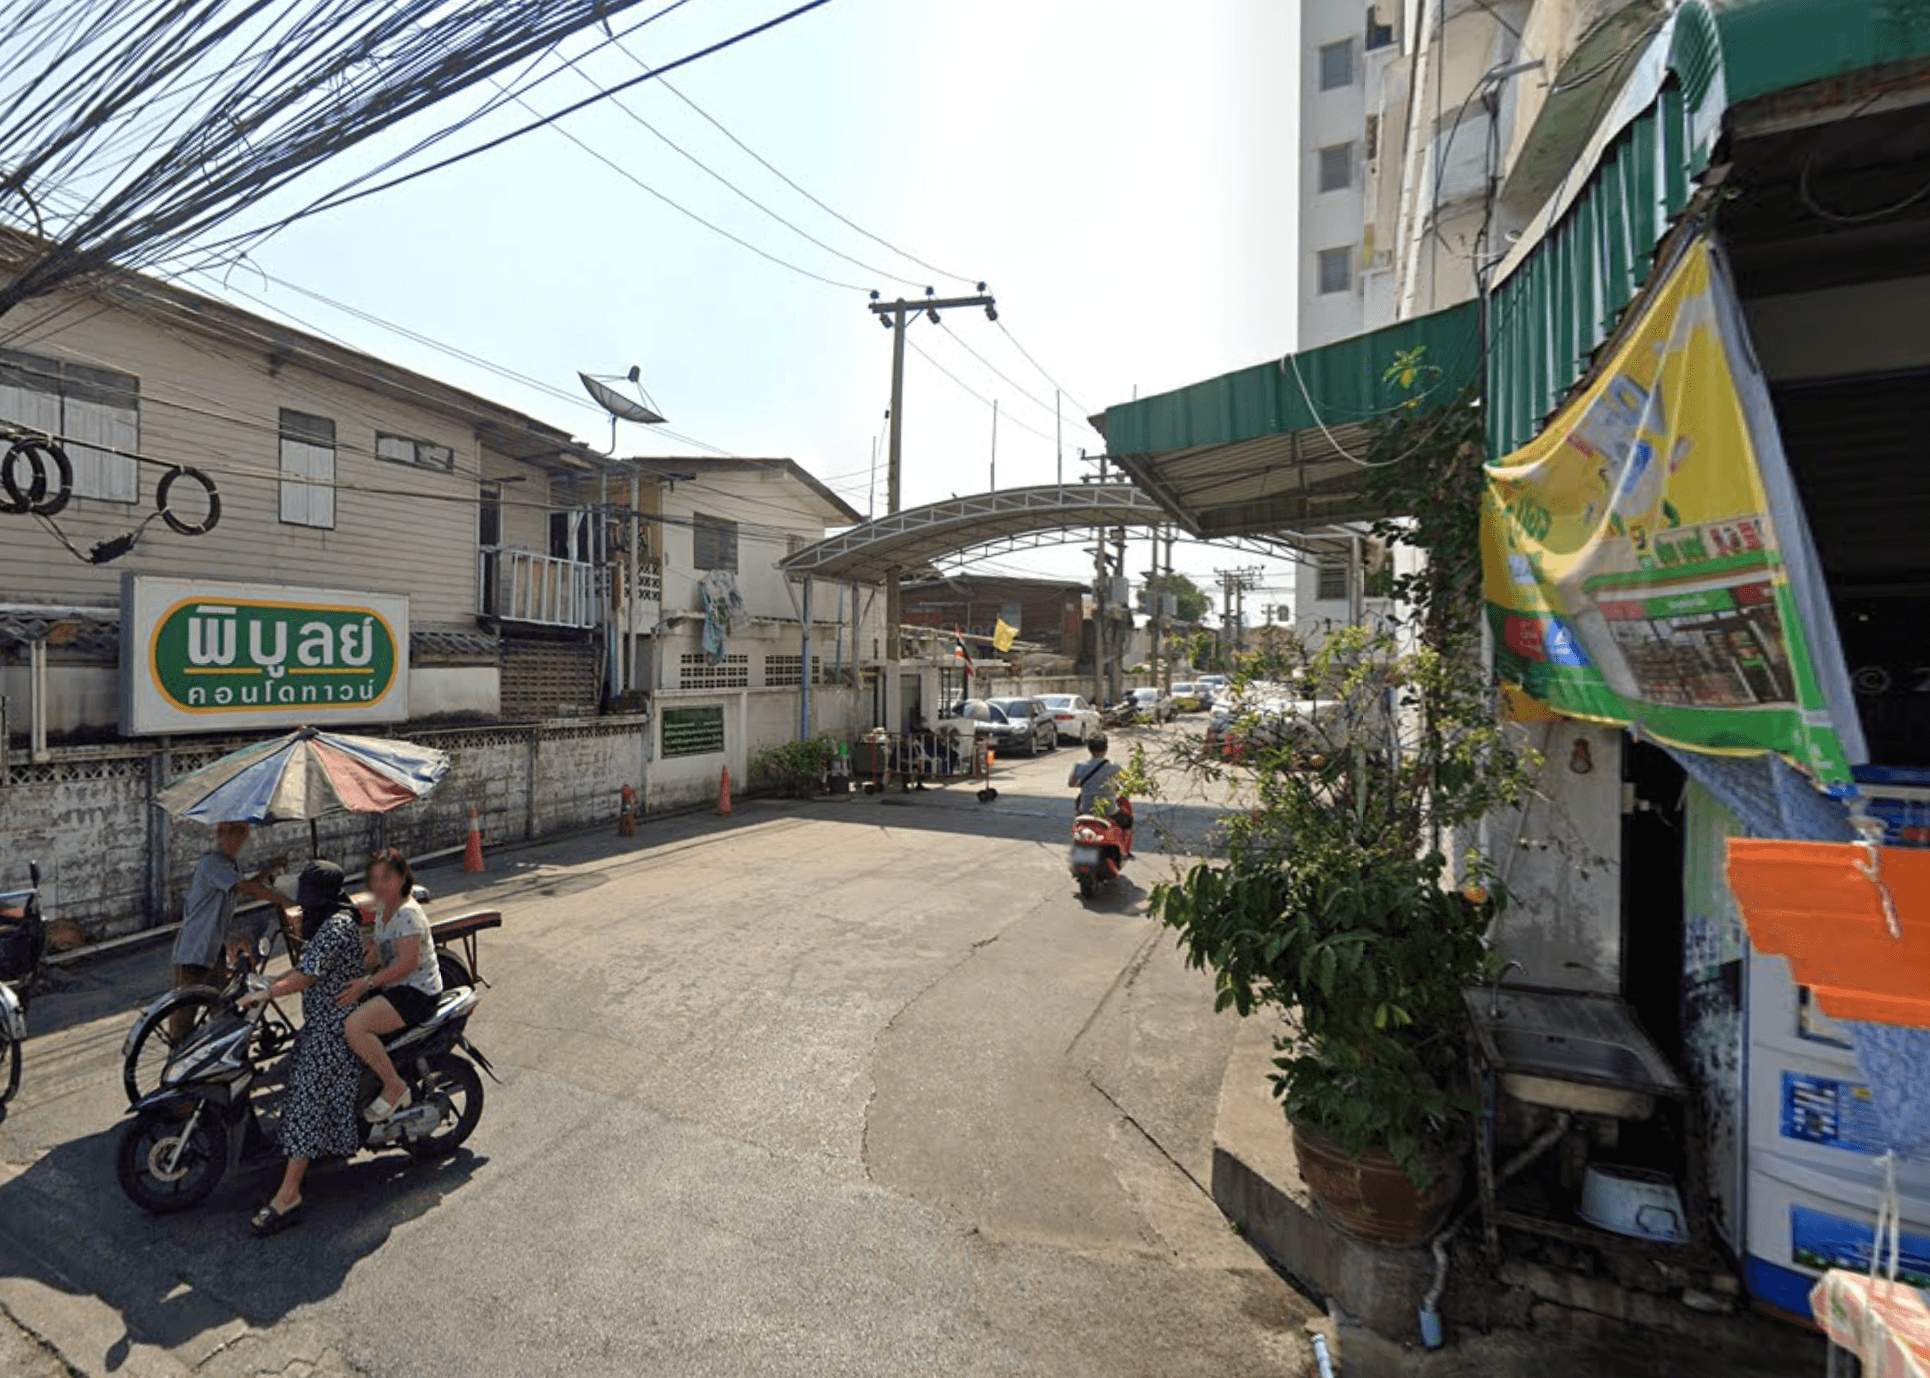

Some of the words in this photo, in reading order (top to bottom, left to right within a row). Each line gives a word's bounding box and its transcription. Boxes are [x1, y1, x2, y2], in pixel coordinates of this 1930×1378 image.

[187, 605, 375, 678] พิบูลย์
[187, 679, 374, 705] คอนโดทาวน์
